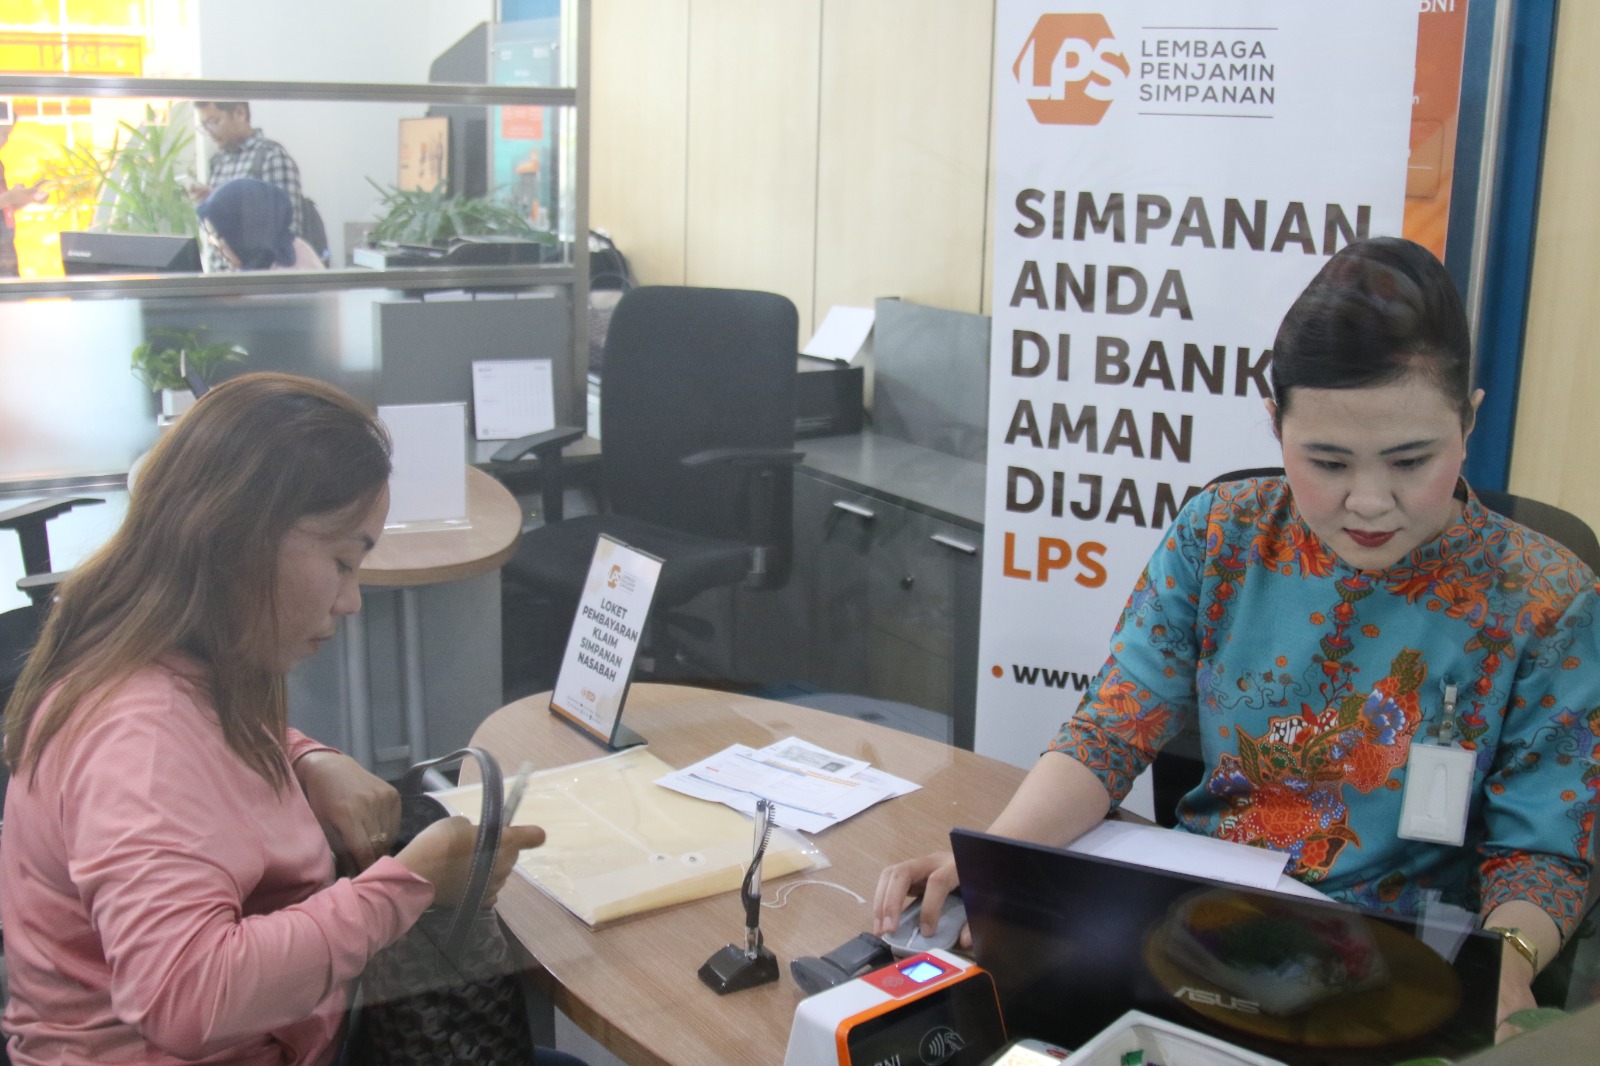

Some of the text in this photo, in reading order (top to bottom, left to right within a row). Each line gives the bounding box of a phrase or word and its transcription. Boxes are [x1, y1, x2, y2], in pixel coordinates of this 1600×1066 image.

[1141, 39, 1267, 60] LEMBAGA
[1013, 37, 1130, 101] LPS
[1140, 62, 1275, 82] PENJAMIN
[1139, 84, 1275, 105] SIMPANAN
[1014, 187, 1371, 256] SIMPANAN
[1010, 259, 1193, 321] ANDA
[1011, 329, 1275, 400] DI BANK
[1004, 398, 1193, 464] AMAN
[1003, 531, 1108, 589] LPS
[583, 605, 638, 642] PEMBAYARAN
[600, 598, 628, 620] LOKET
[592, 626, 618, 649] KLAIM
[577, 652, 617, 682] NASABAH
[580, 638, 623, 668] SIMPANAN
[1174, 987, 1260, 1014] ASUS
